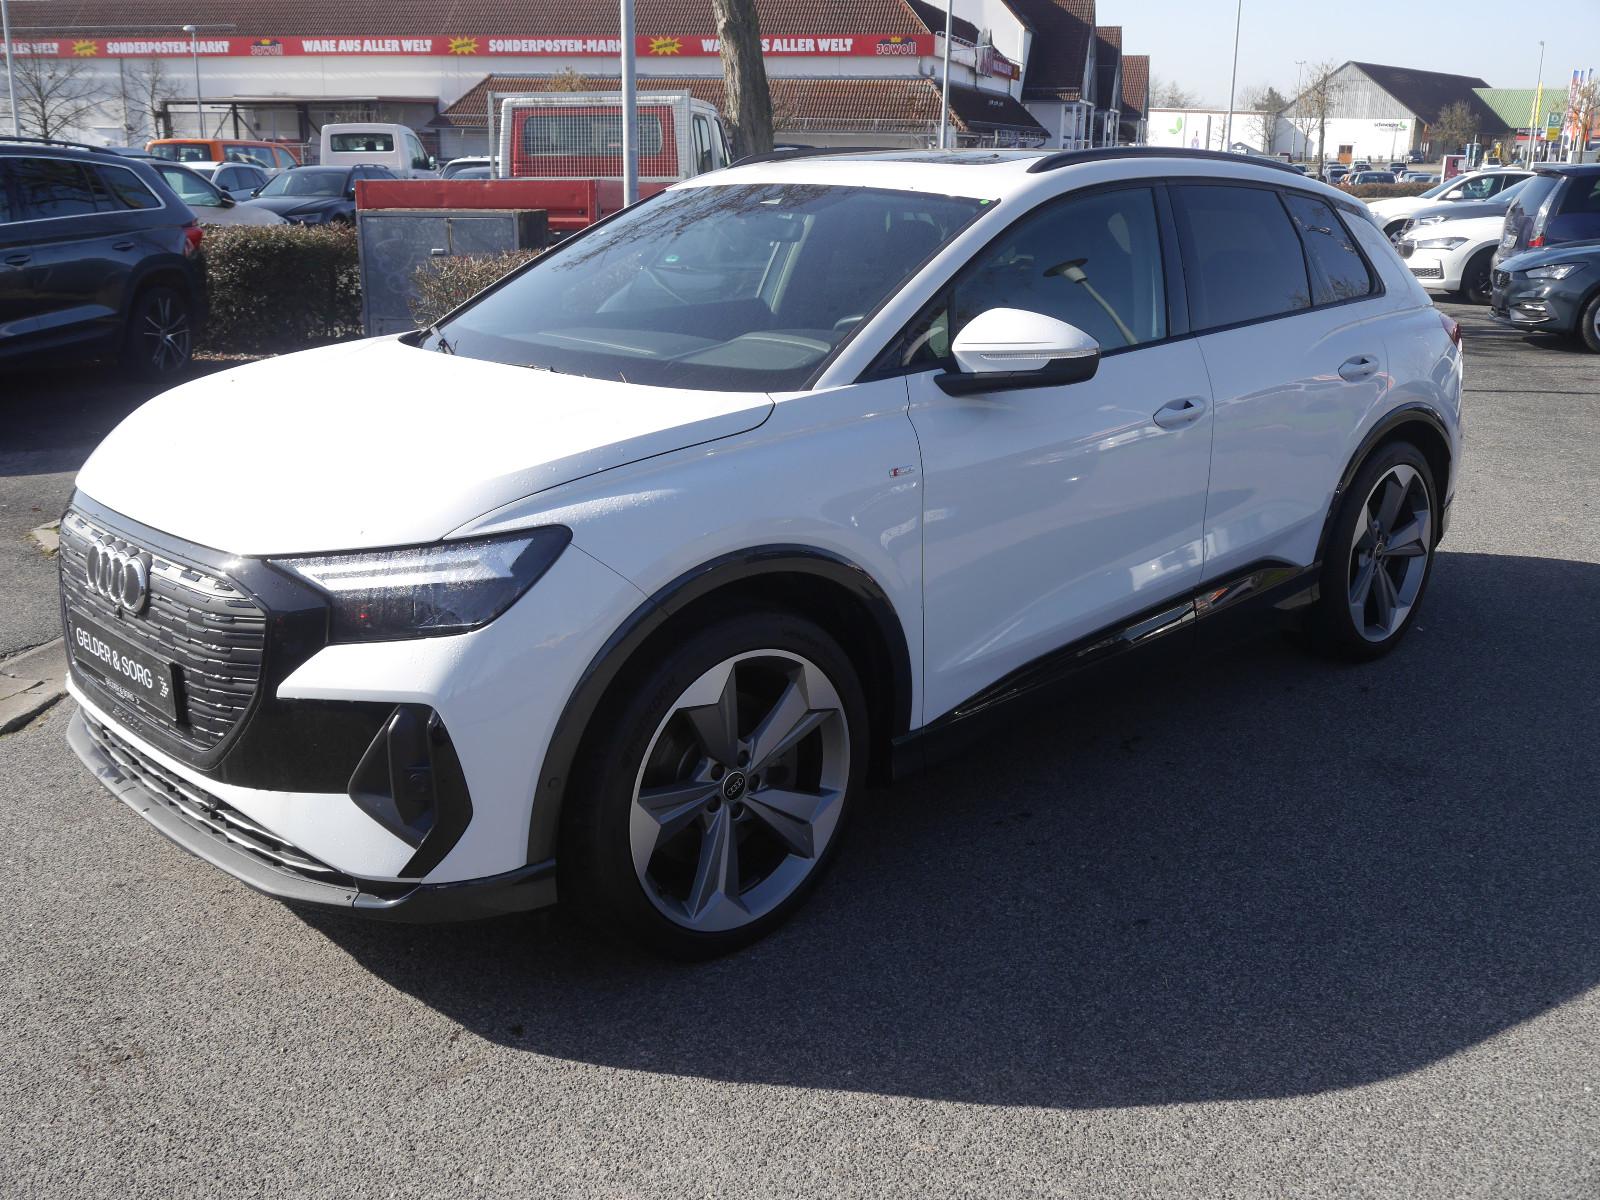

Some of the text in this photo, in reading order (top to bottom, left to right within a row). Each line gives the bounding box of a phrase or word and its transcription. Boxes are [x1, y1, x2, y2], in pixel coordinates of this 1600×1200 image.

[106, 42, 229, 54] SONDERPOSTEN-MARKT
[302, 40, 432, 52] WARE AUS ALLER WELT
[488, 39, 622, 52] SONDERPOSTEN-MARK
[701, 38, 721, 52] WA
[772, 38, 815, 52] ALLER
[817, 38, 853, 52] WELT
[76, 627, 112, 666] GELDER
[112, 650, 121, 672] &
[121, 656, 153, 689] SORG
